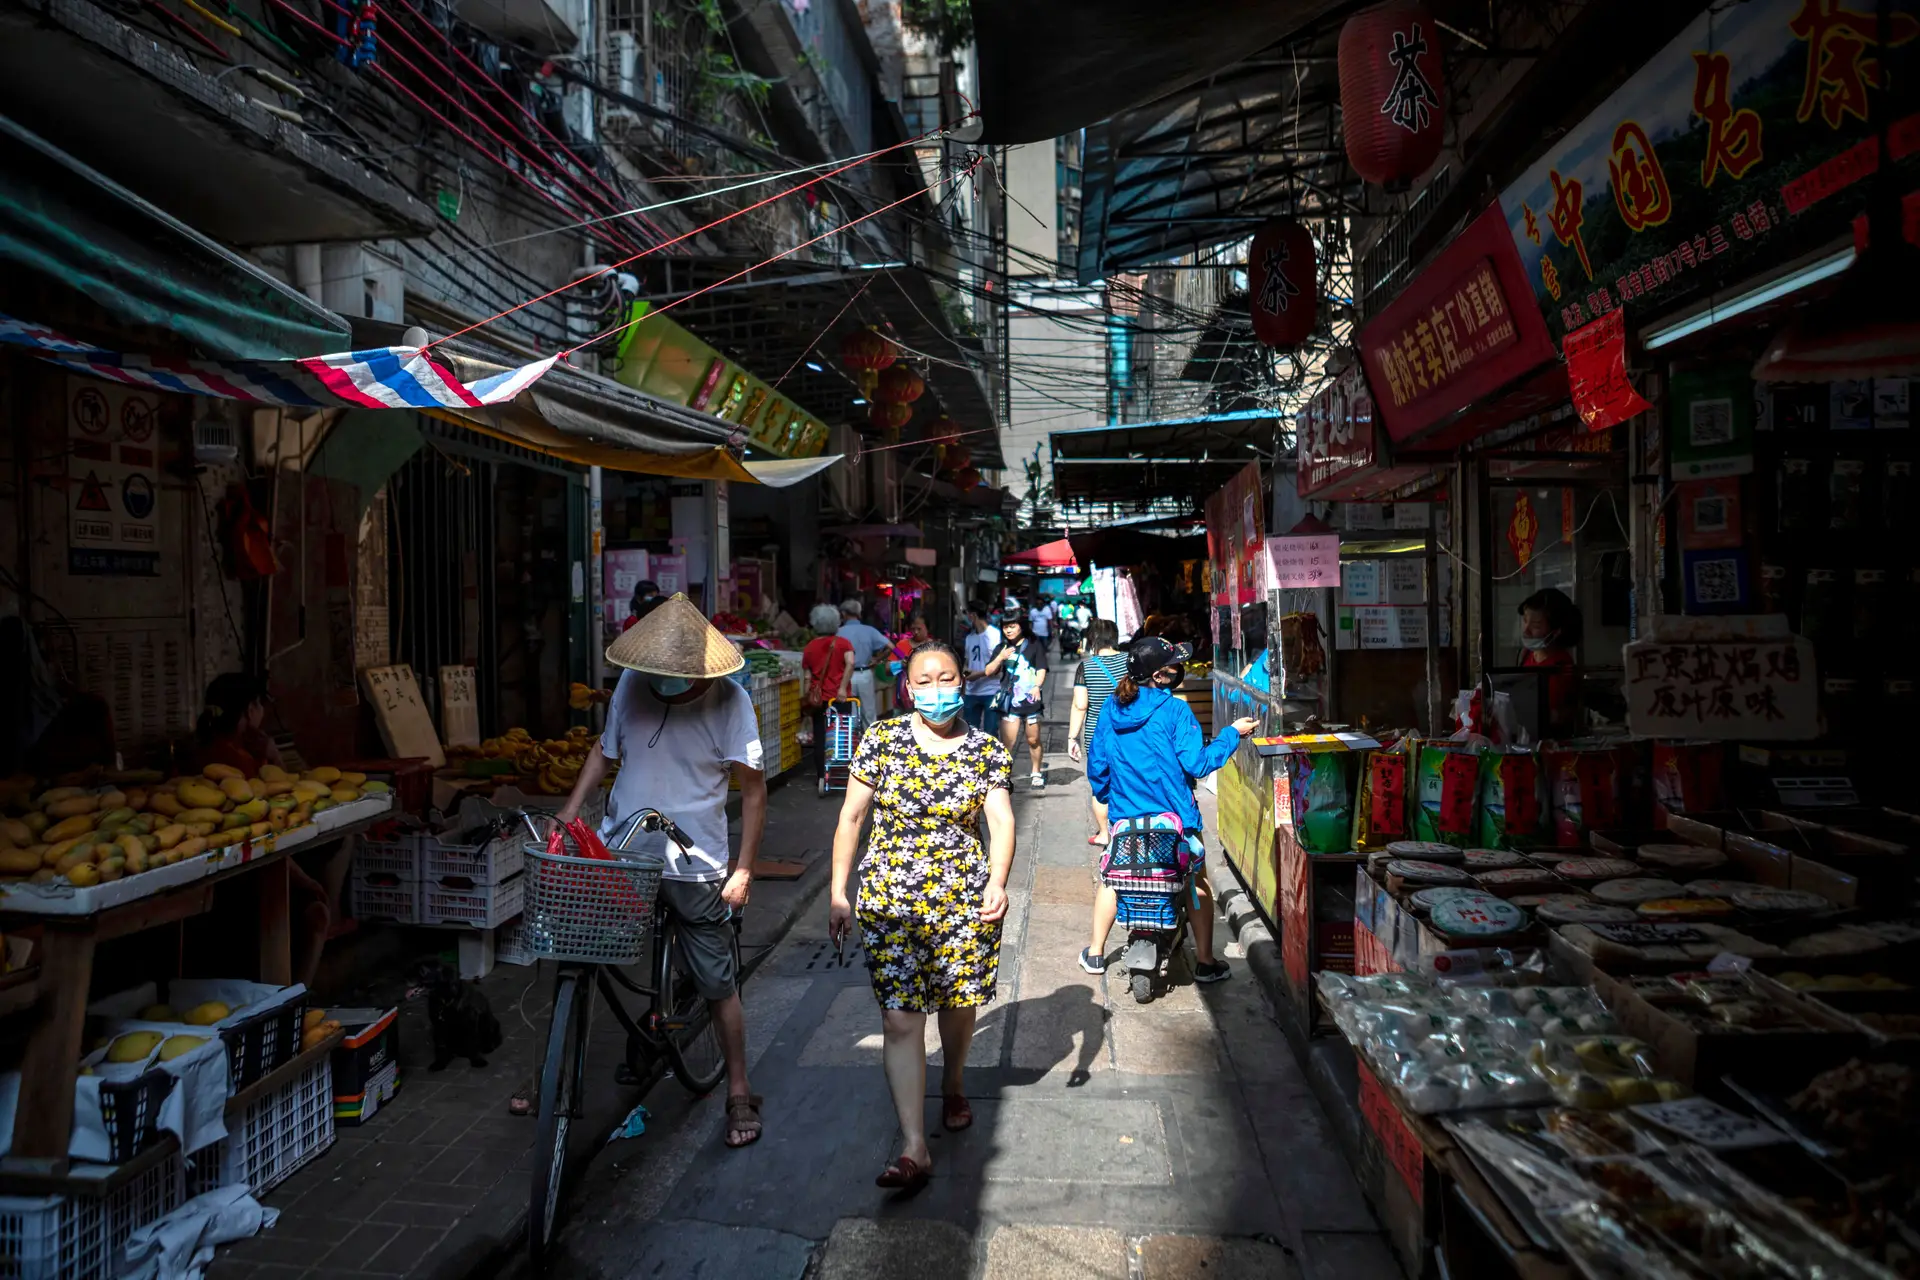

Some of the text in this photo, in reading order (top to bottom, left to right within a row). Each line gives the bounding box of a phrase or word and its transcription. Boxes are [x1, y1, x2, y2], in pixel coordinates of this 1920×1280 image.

[1381, 22, 1439, 133] 茶
[1547, 0, 1919, 281] 中国名茶
[1258, 239, 1300, 316] 茶
[1647, 685, 1786, 723] 原汁原味
